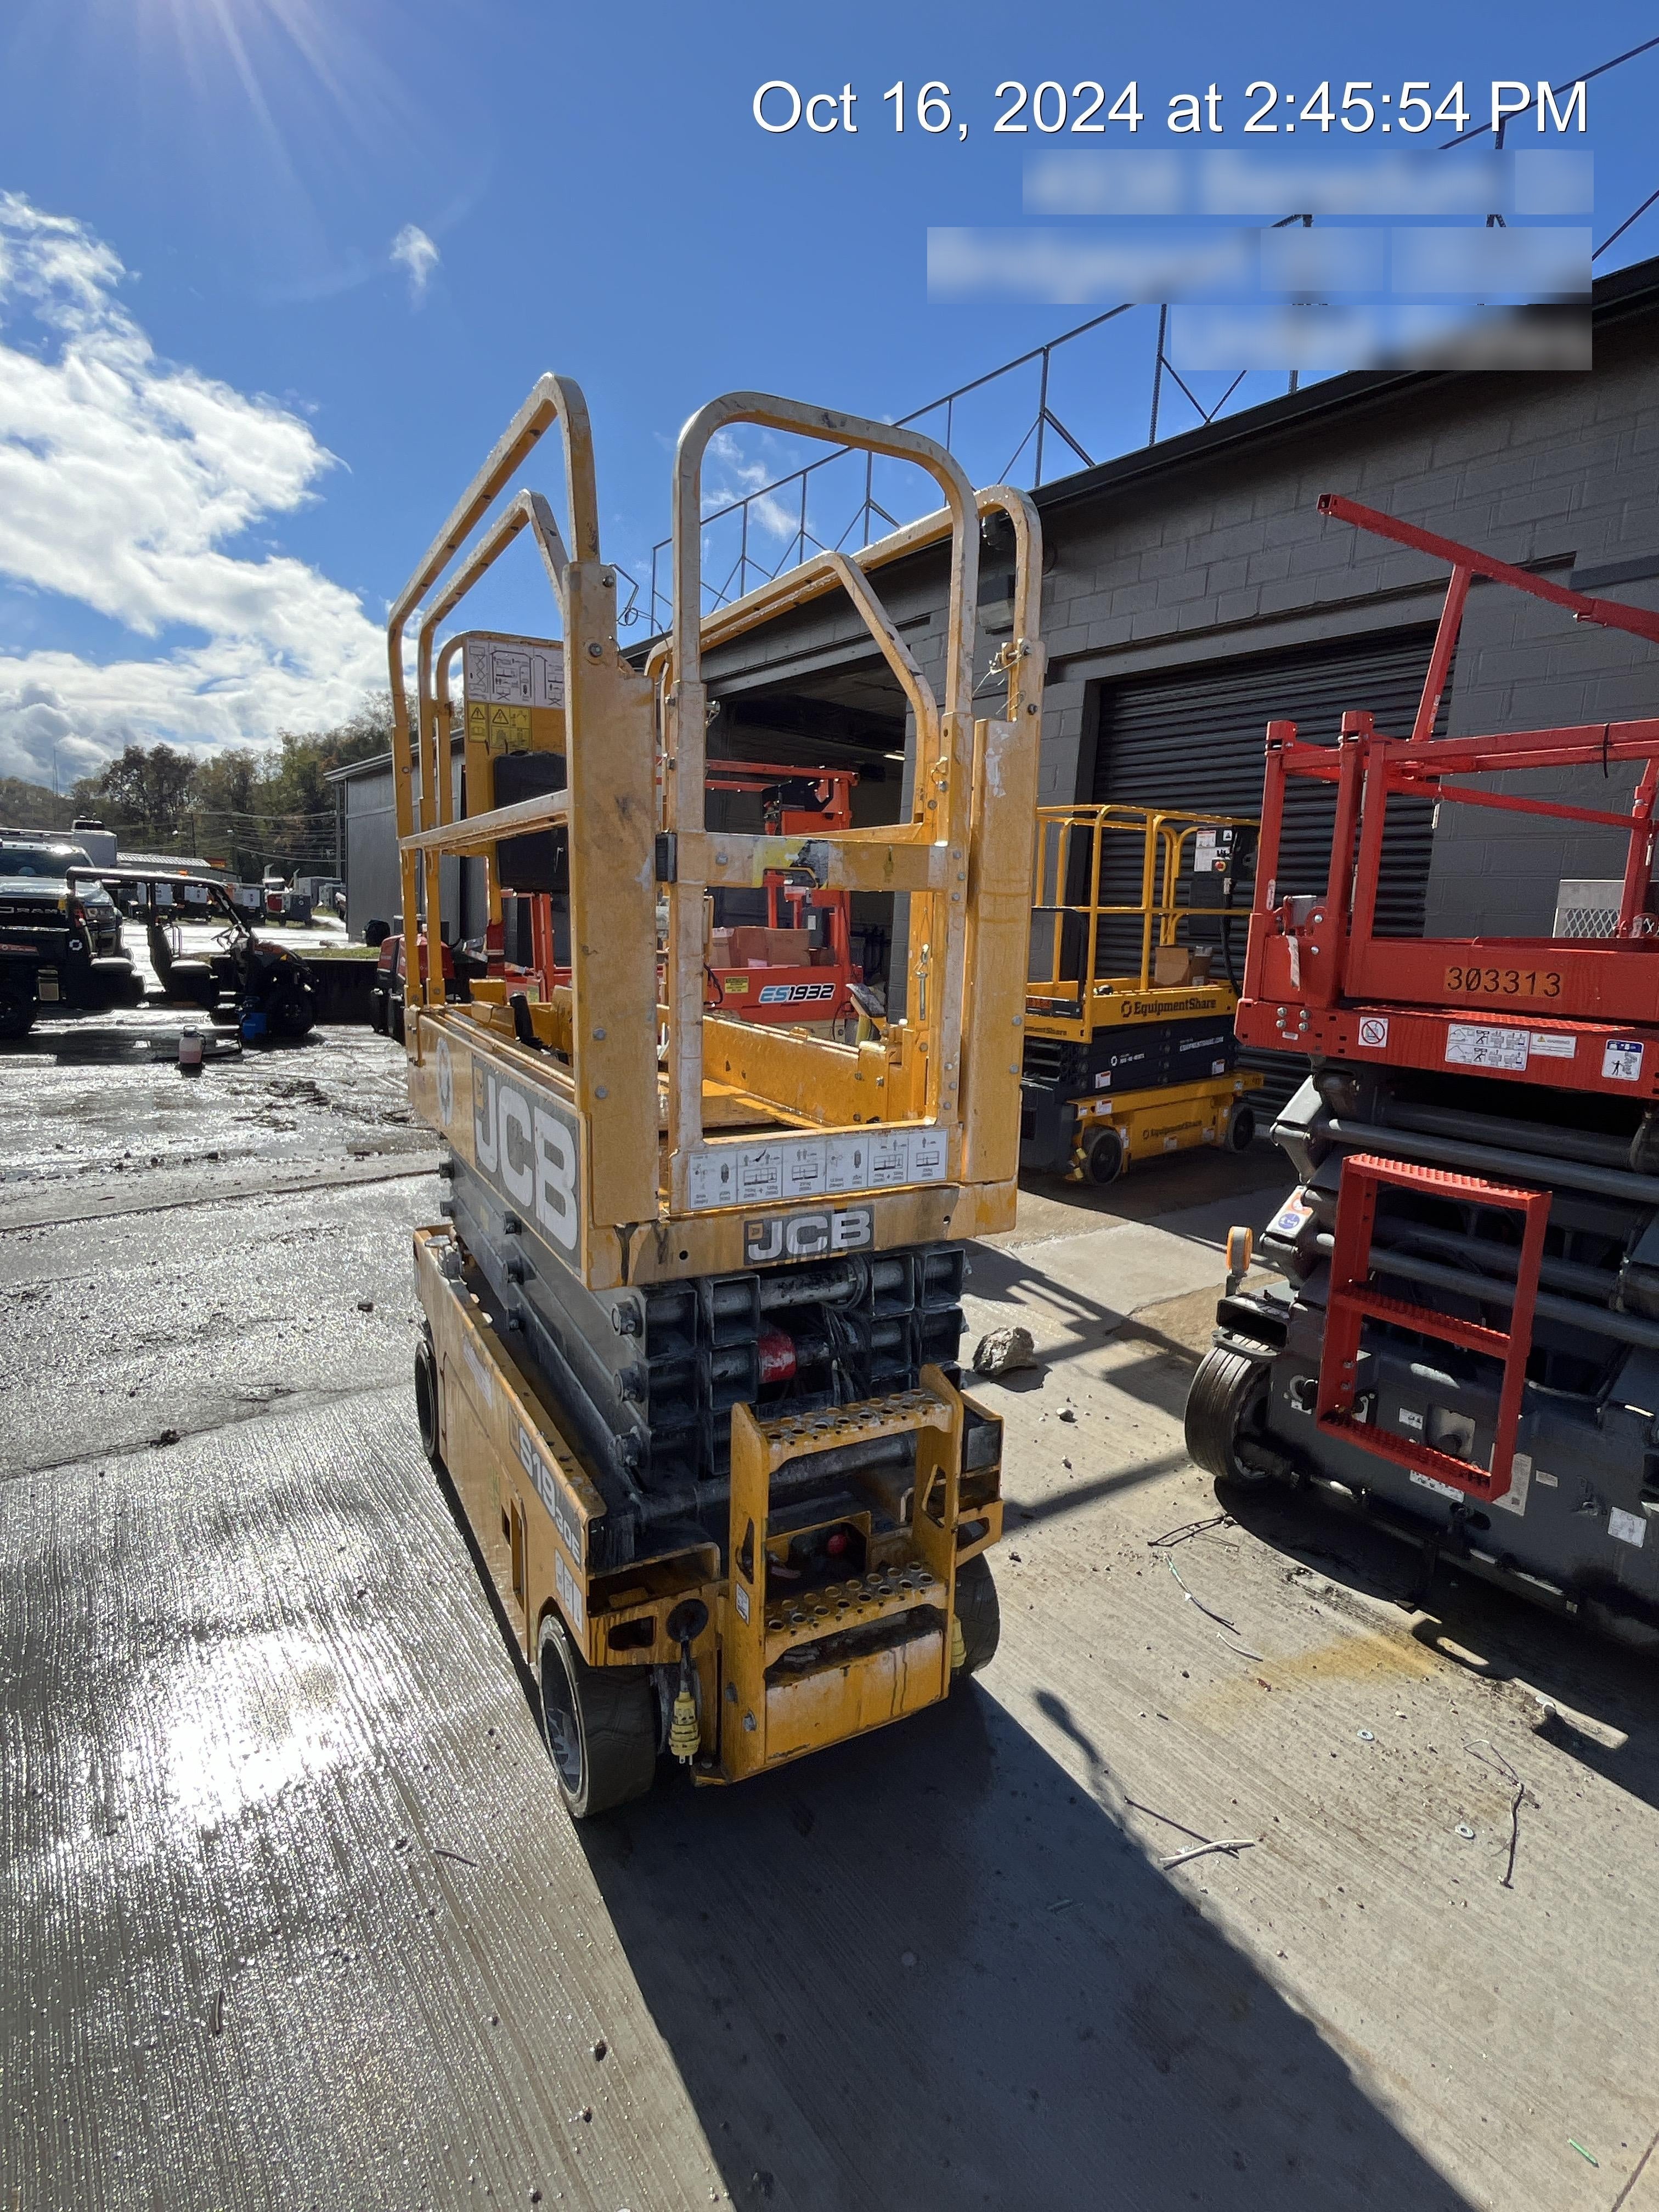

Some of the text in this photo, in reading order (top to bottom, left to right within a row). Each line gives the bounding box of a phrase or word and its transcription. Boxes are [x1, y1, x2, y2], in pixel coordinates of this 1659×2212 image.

[759, 984, 836, 1003] ES1932
[1447, 967, 1561, 997] 303313
[1133, 998, 1216, 1015] EquipmentShare
[475, 1074, 578, 1250] JCB
[748, 1210, 871, 1261] JCB
[518, 1426, 581, 1565] S1930E
